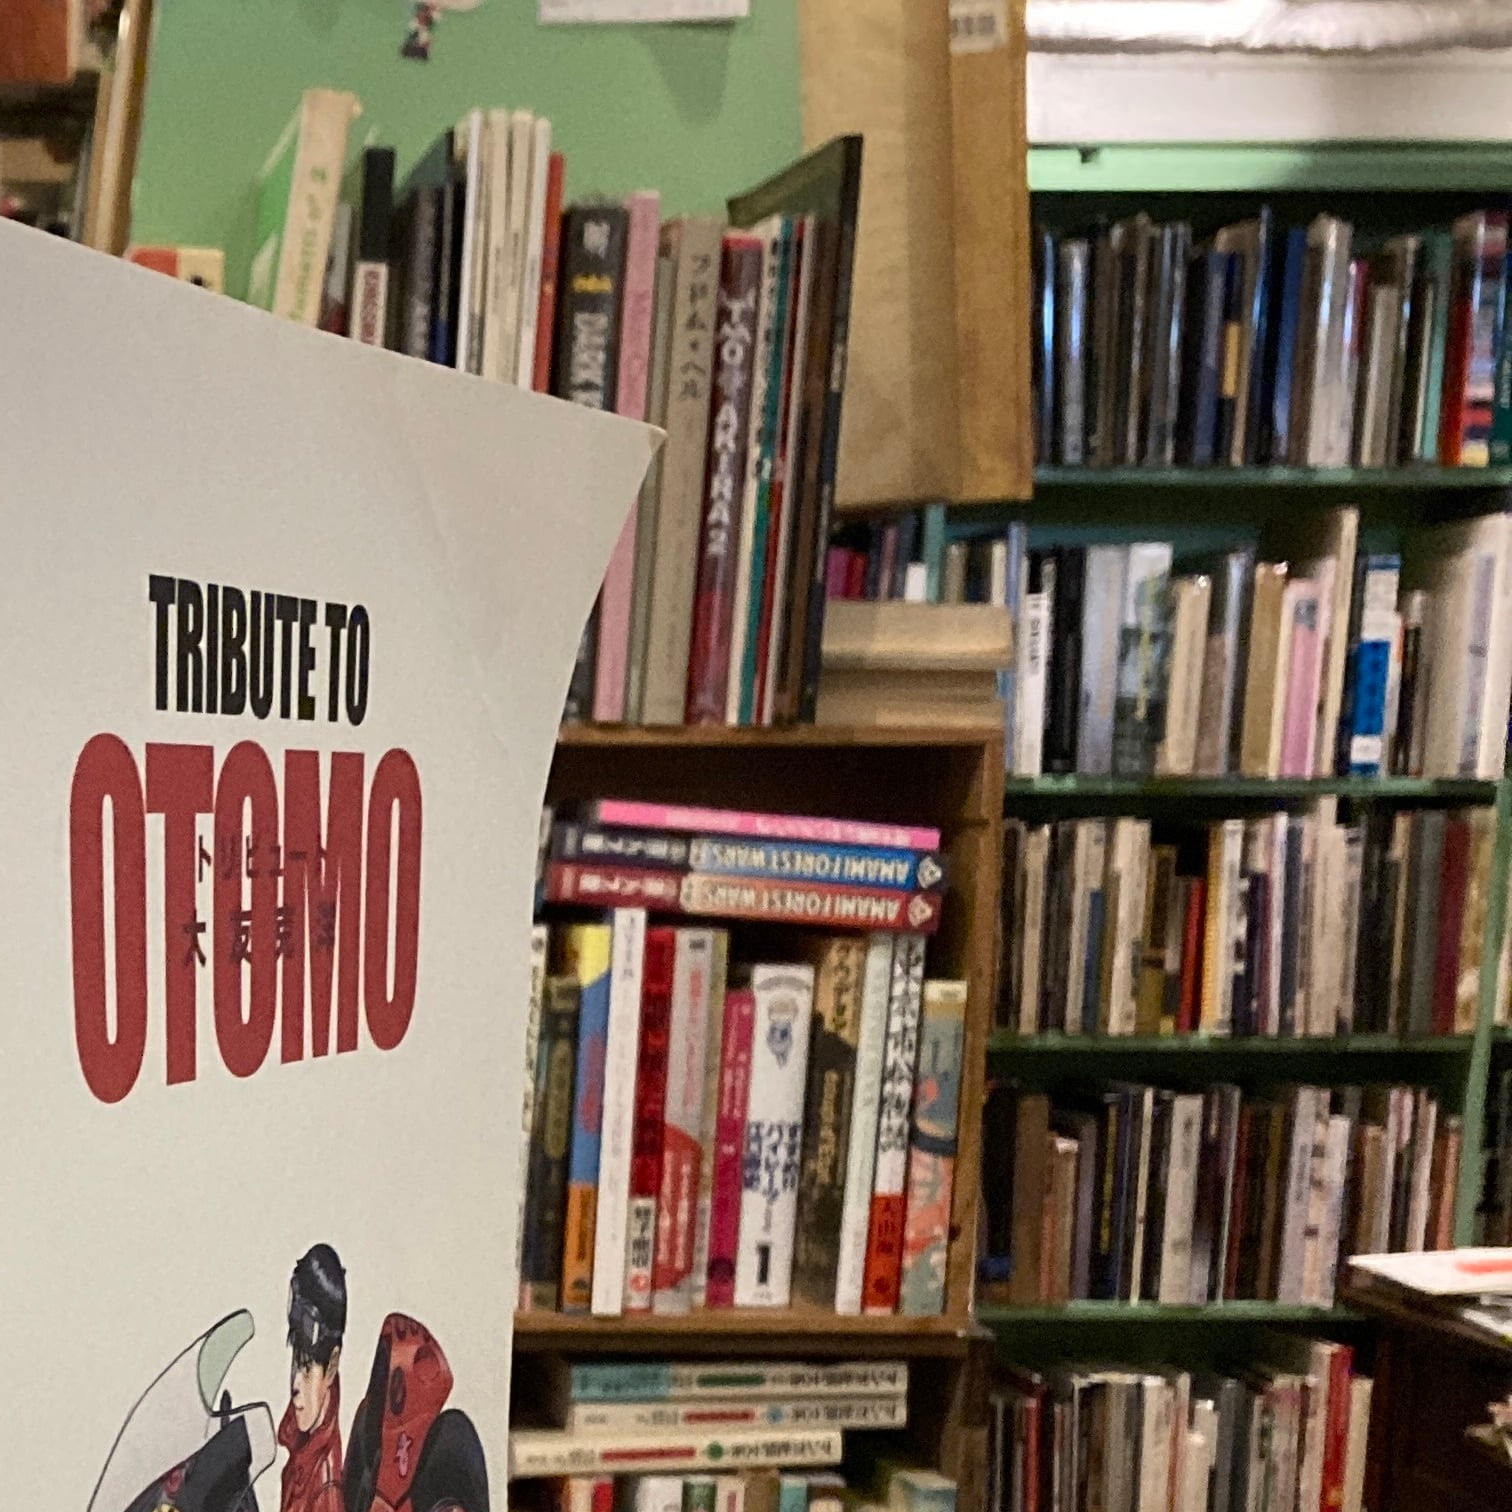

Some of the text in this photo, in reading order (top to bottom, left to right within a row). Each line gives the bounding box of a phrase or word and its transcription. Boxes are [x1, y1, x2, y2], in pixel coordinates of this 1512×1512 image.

[148, 574, 370, 727] TRIBUTE TO
[836, 893, 901, 922] AMAMI
[845, 857, 910, 886] AMAMI
[70, 732, 422, 1104] OTOMO
